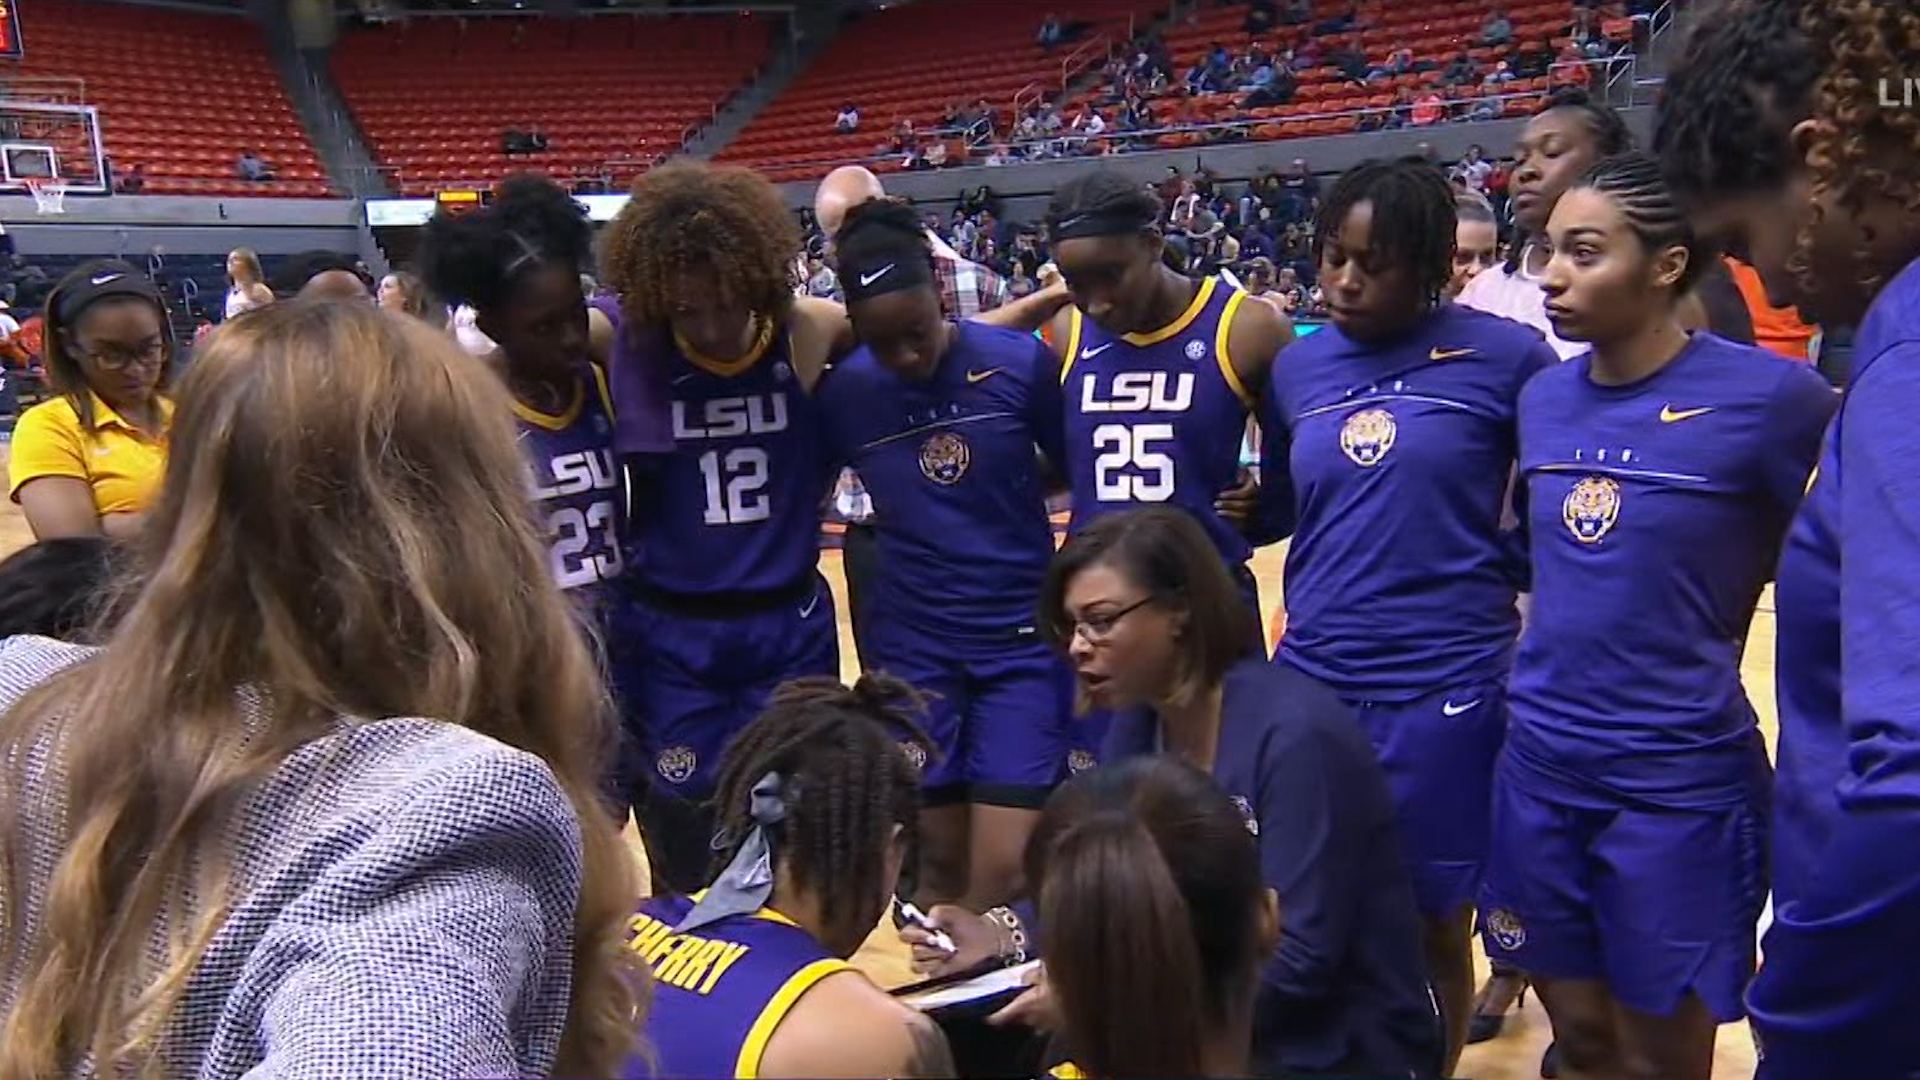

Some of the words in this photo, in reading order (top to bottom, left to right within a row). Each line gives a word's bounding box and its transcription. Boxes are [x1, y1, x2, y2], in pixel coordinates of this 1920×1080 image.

[673, 393, 788, 438] LSU
[1081, 372, 1195, 412] LSU
[528, 449, 617, 499] LSU
[699, 447, 770, 525] 12
[1093, 424, 1176, 502] 25
[548, 500, 624, 589] 23
